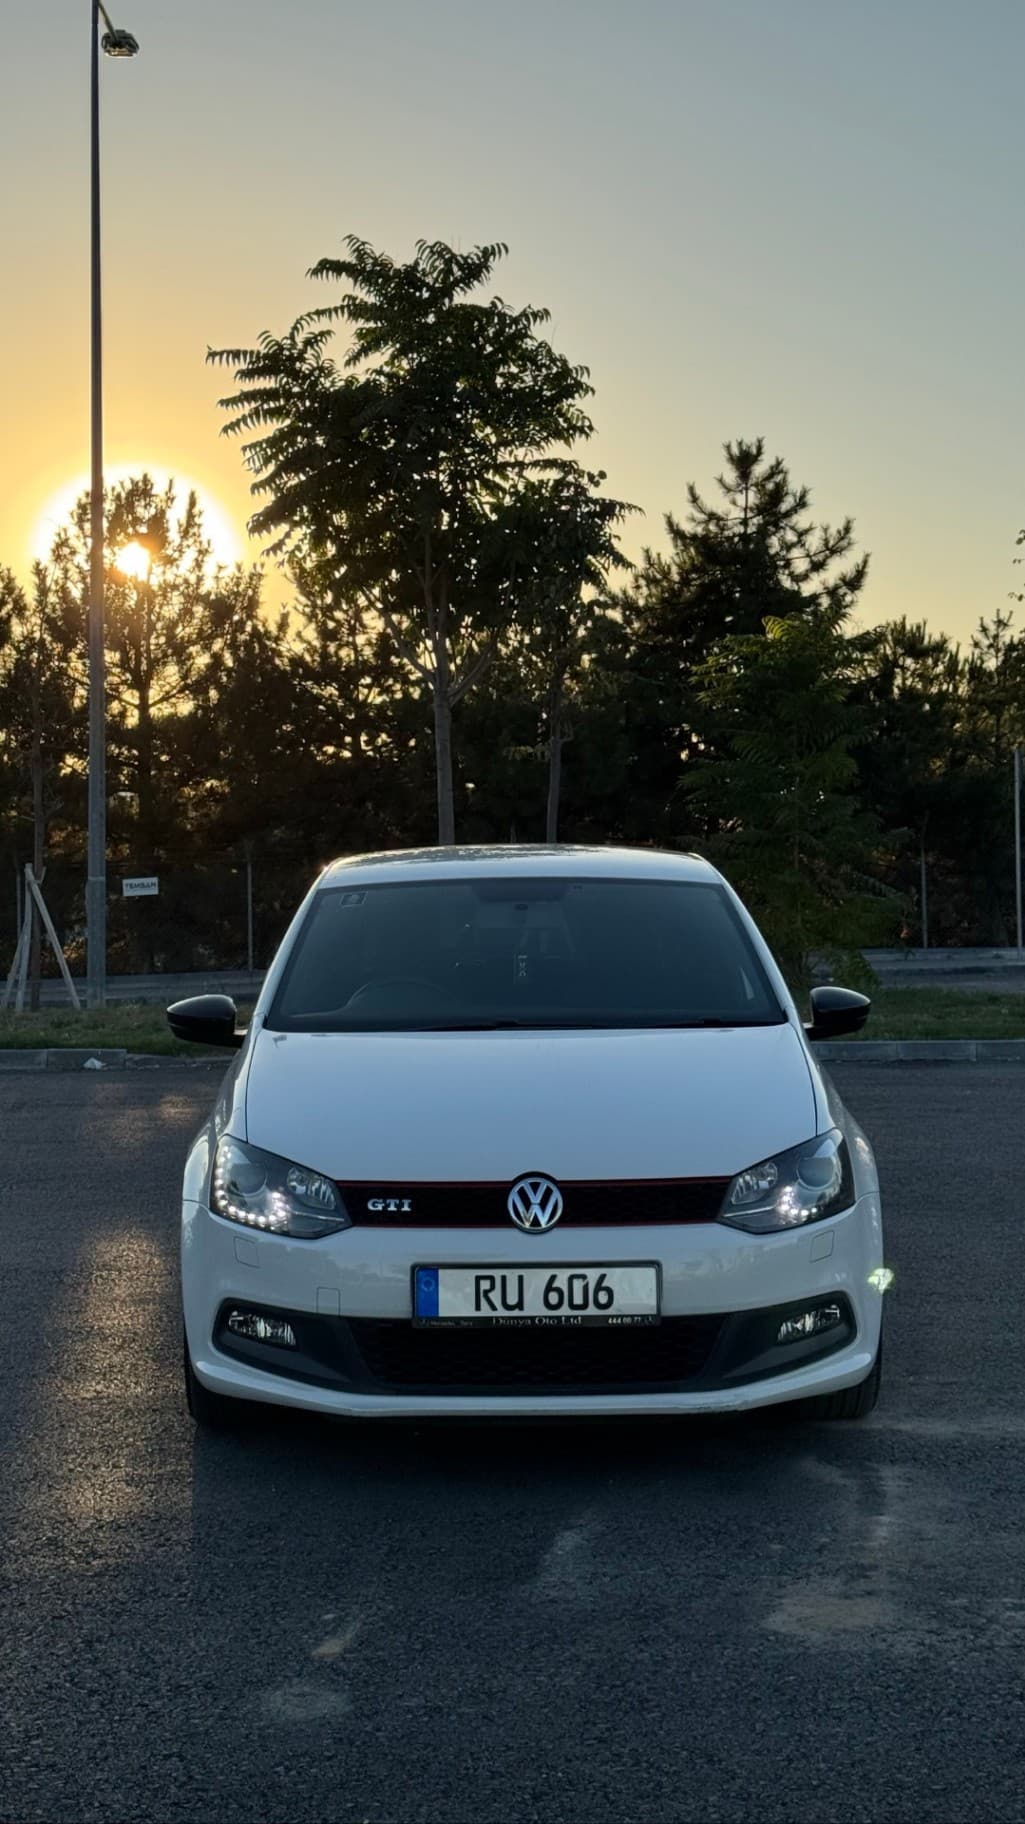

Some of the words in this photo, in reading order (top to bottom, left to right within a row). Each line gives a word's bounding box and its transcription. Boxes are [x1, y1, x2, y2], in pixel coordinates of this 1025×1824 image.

[367, 1198, 412, 1211] GTI
[474, 1274, 525, 1312] RU
[543, 1273, 614, 1311] 606
[561, 1315, 582, 1326] Ltd
